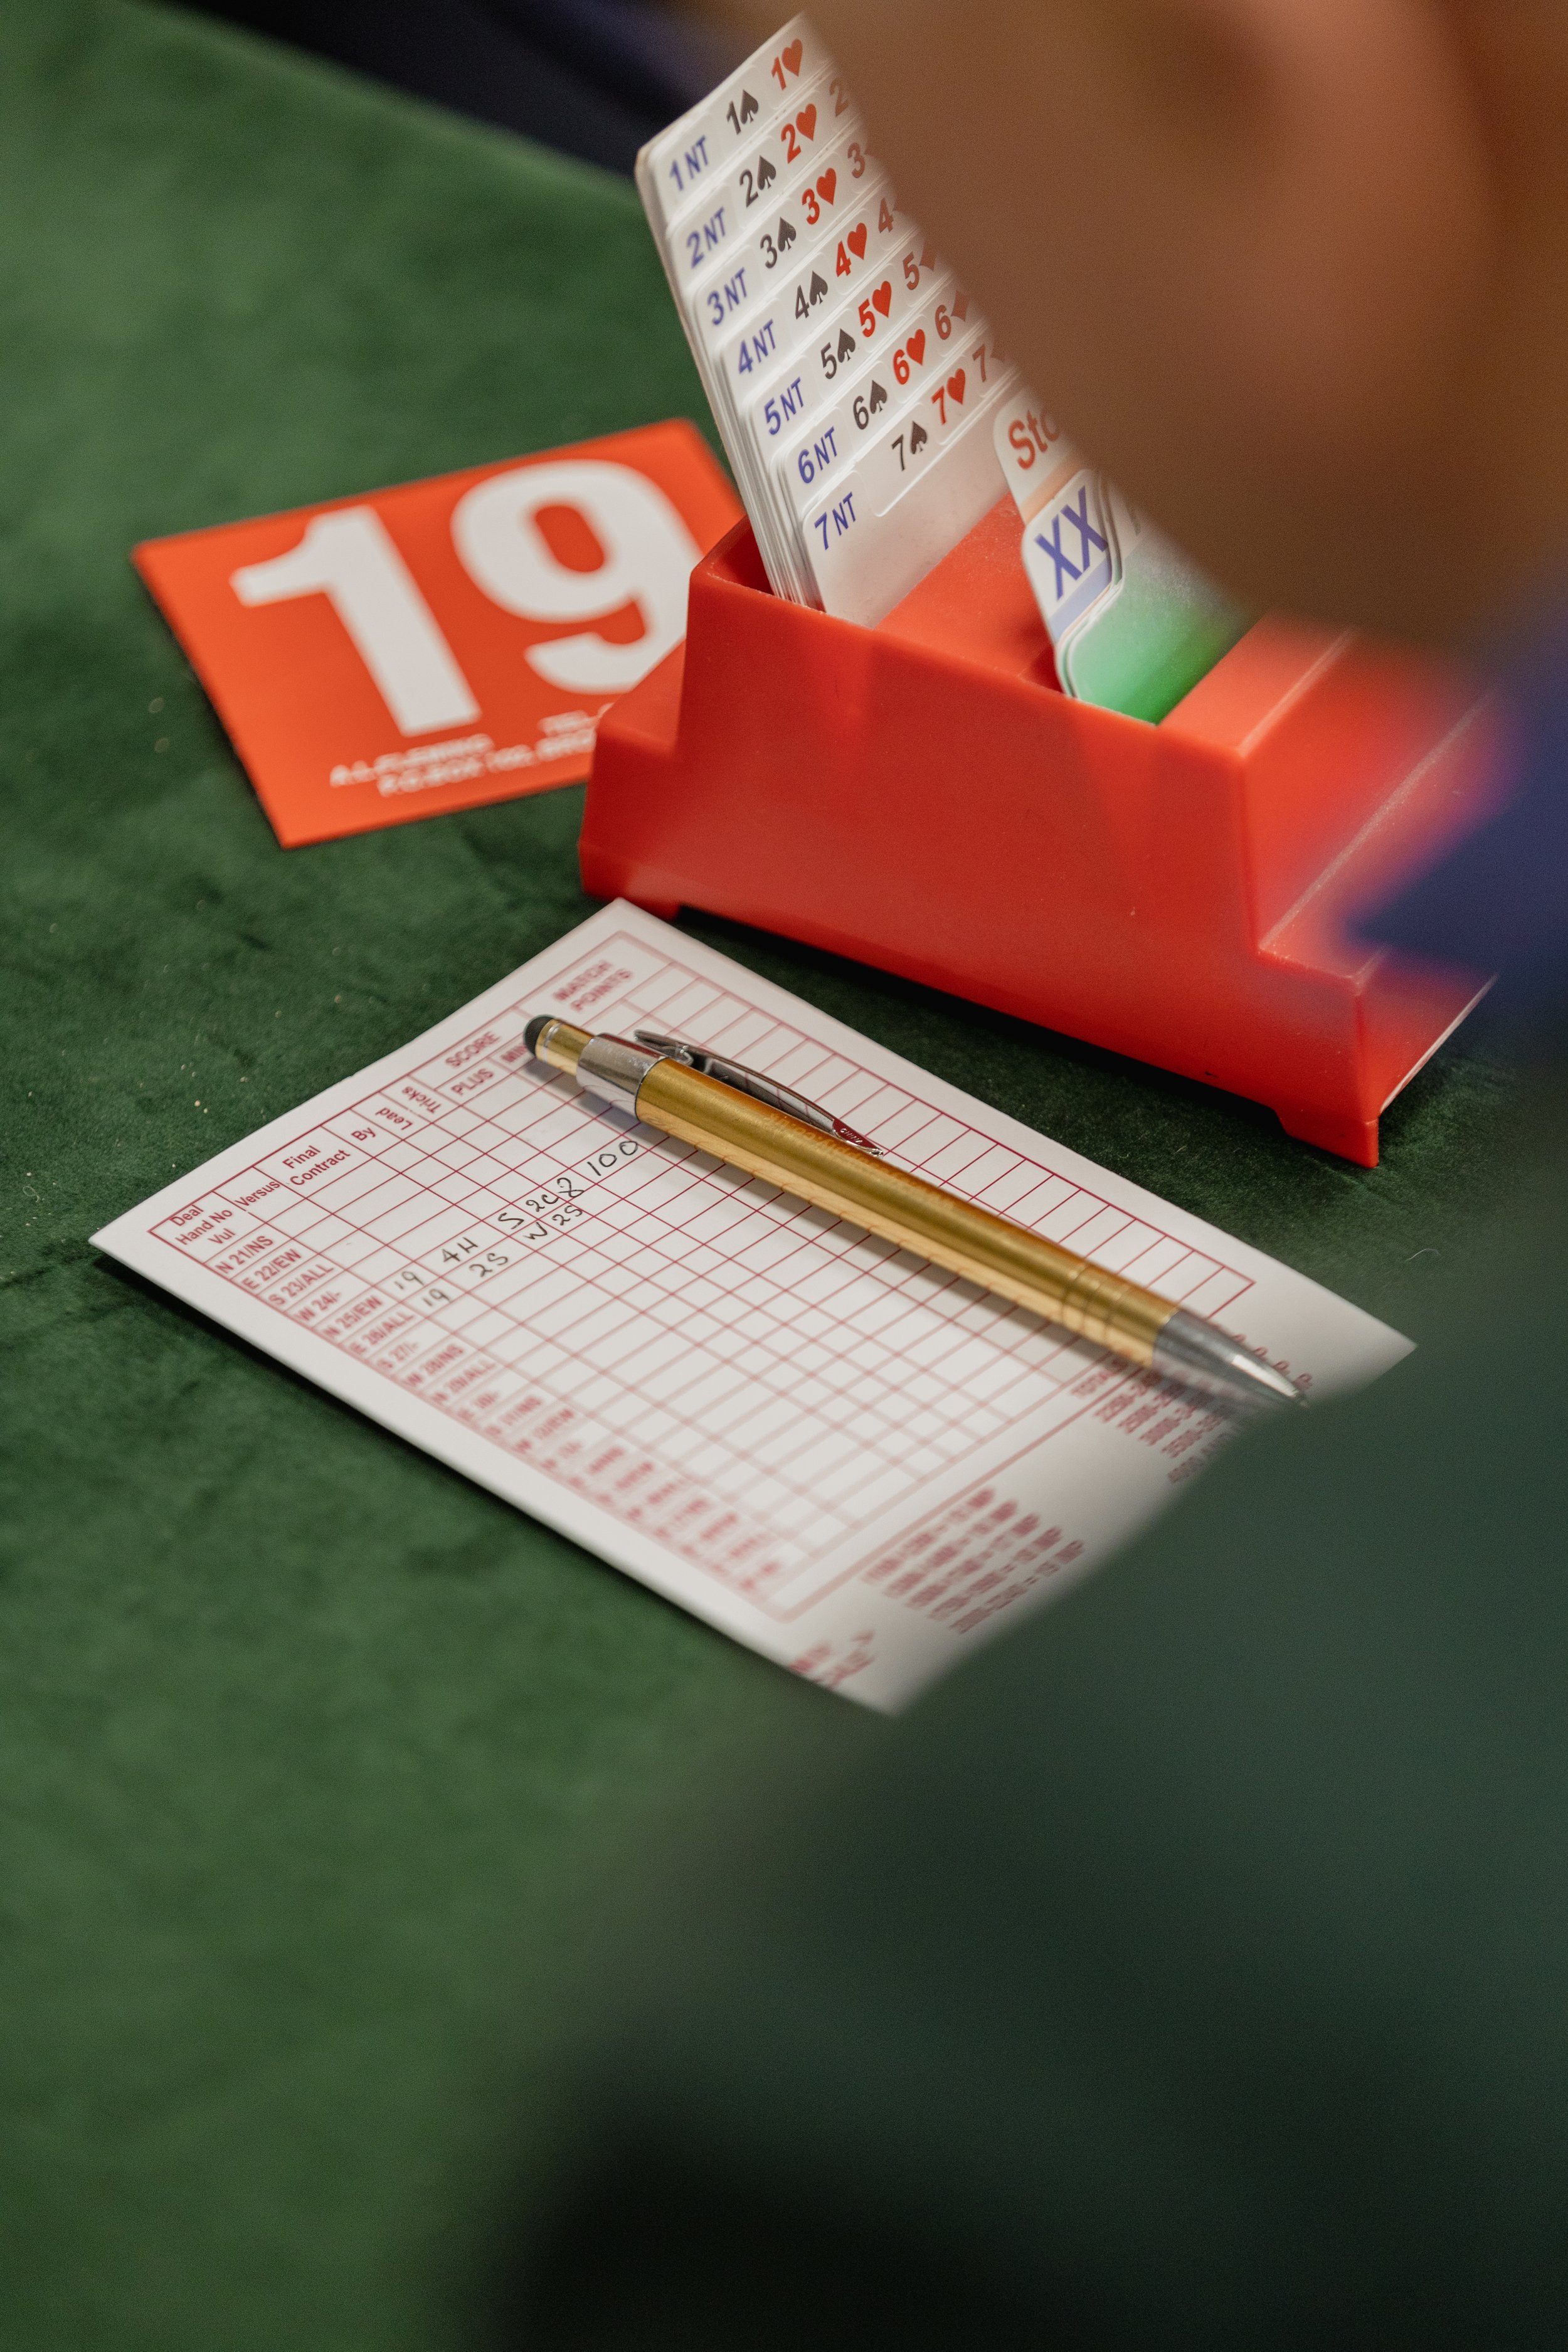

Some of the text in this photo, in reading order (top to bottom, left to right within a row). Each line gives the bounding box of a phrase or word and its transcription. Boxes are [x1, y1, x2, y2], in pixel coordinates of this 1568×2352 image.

[1007, 410, 1060, 470] Sto
[1034, 484, 1109, 602] XX
[230, 457, 701, 737] 19
[552, 960, 613, 1002] MATCH
[569, 968, 632, 1013] POINTS
[445, 1030, 501, 1068] SCORE
[450, 1044, 528, 1097] PLUS MIN
[374, 1107, 414, 1131] Lead
[401, 1086, 442, 1114] Tricks
[351, 1126, 377, 1142] By
[282, 1145, 321, 1170] Final
[289, 1148, 352, 1187] Contract
[586, 1140, 639, 1177] 100
[235, 1180, 281, 1208] Versus
[169, 1204, 204, 1227] Deal
[175, 1208, 233, 1246] Hand No
[208, 1228, 236, 1247] Vul
[215, 1234, 275, 1275] N 21/NS
[241, 1248, 304, 1291] E 22/EW
[268, 1264, 334, 1308] S 23/ALL
[293, 1306, 316, 1322] W
[322, 1295, 383, 1338] N 25/EW
[349, 1342, 368, 1355] E
